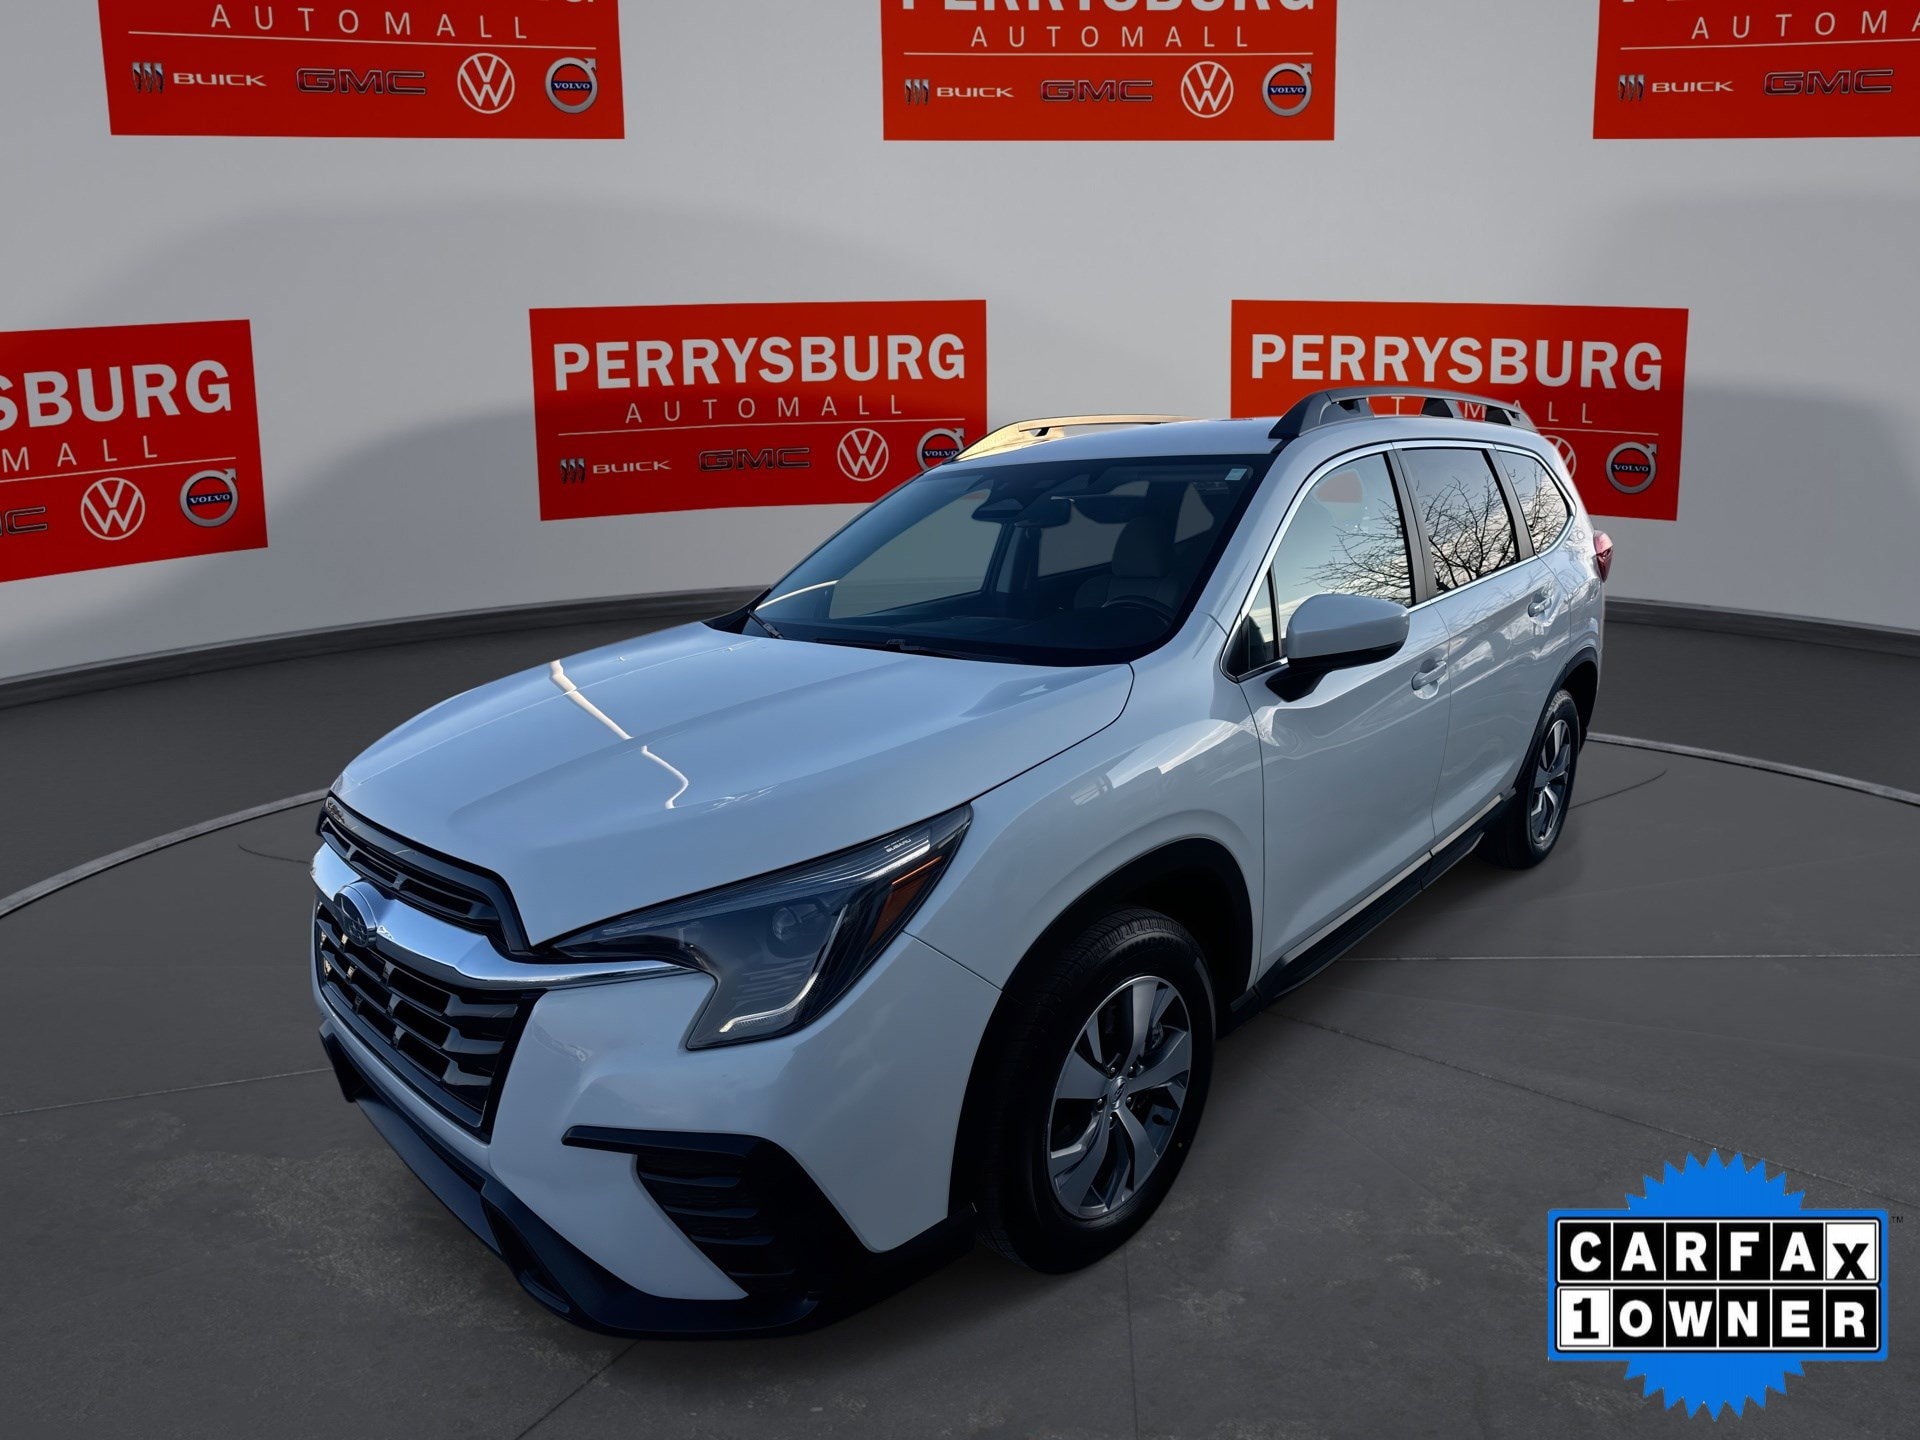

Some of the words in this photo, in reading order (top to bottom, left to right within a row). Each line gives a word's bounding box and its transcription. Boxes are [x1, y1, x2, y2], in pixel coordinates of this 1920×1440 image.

[210, 4, 527, 39] AUTOMALL
[971, 26, 1248, 48] AUTOMALL
[173, 72, 267, 87] BUICK
[296, 66, 427, 96] GMC
[553, 81, 591, 91] VOLVO
[936, 86, 1014, 98] BUICK
[1040, 79, 1153, 103] GMC
[1270, 86, 1305, 95] VOLVO
[1652, 81, 1734, 93] BUICK
[1763, 68, 1894, 96] GMC
[553, 333, 966, 391] PERRYSBURG
[1251, 333, 1663, 392] PERRYSBURG
[625, 394, 902, 424] AUTOMALL
[1, 435, 158, 473] MALL
[592, 460, 672, 474] BUICK
[698, 447, 810, 472] GMC
[1612, 463, 1649, 473] VOLVO
[189, 494, 231, 504] VOLVO
